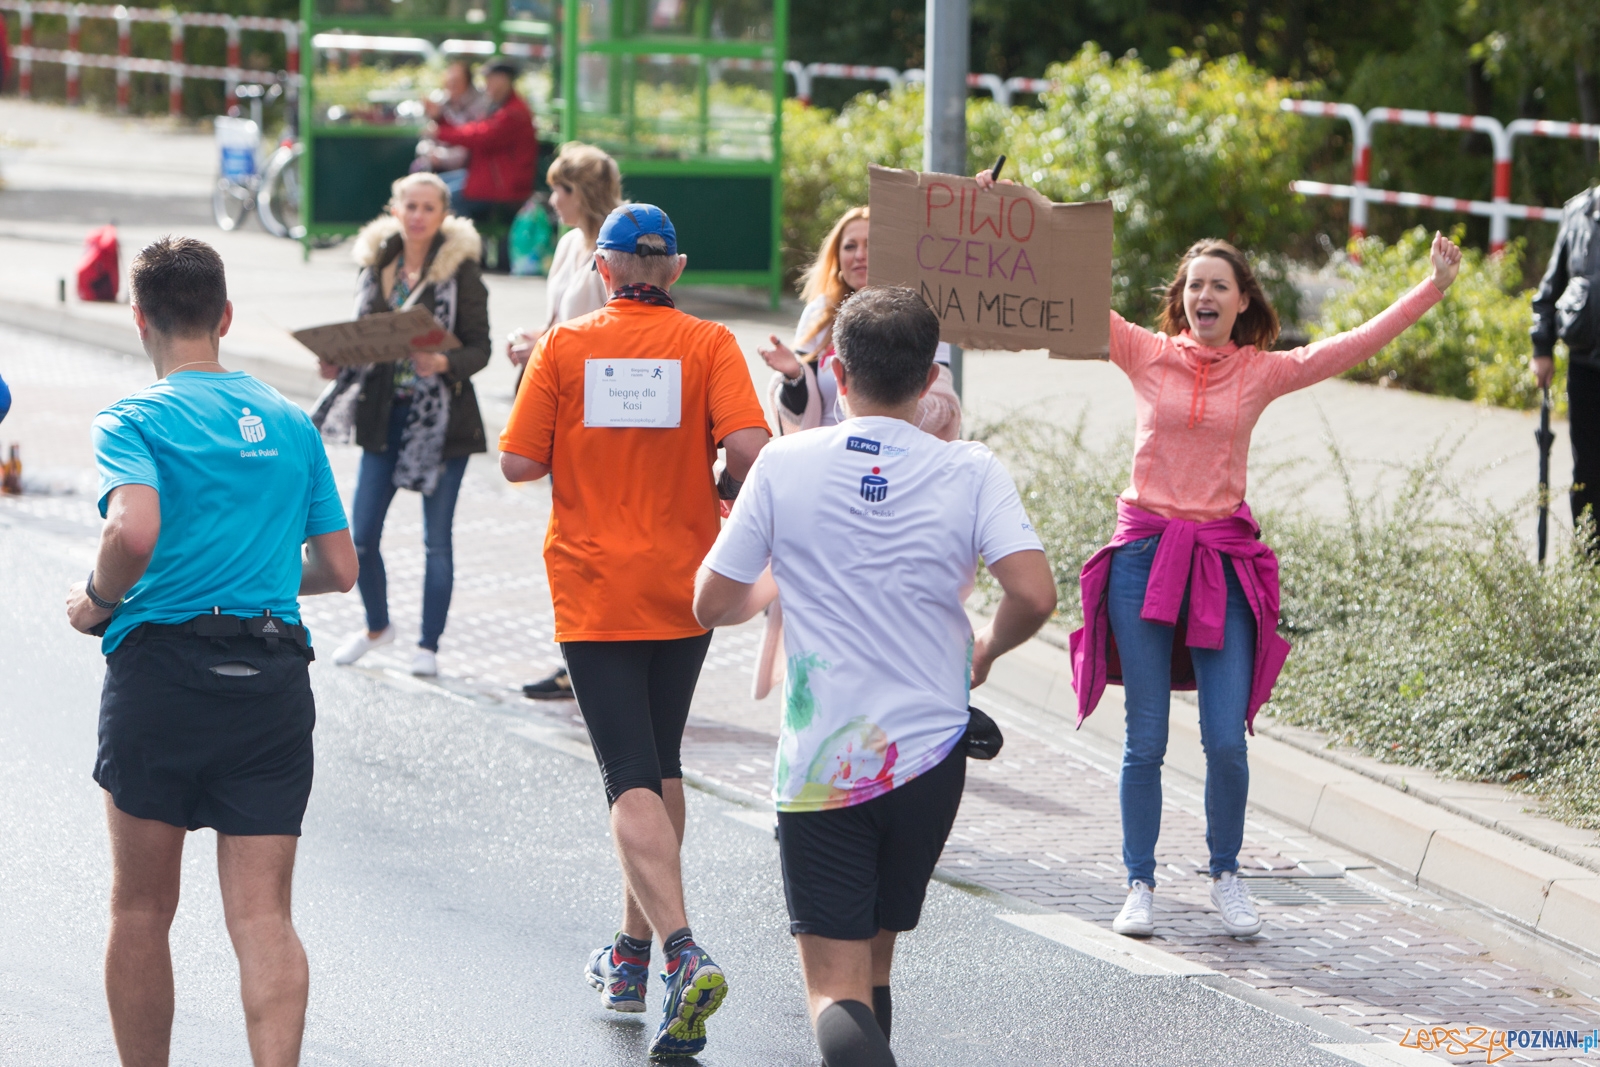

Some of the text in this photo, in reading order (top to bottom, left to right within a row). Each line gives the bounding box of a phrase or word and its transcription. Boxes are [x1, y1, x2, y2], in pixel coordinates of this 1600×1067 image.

[926, 182, 1035, 243] PIWO
[916, 234, 1037, 285] CZEKA
[920, 280, 1074, 332] NA MECIE!
[609, 388, 656, 399] biegnę dla
[623, 401, 642, 410] Kasi
[240, 448, 278, 458] Bank Polski
